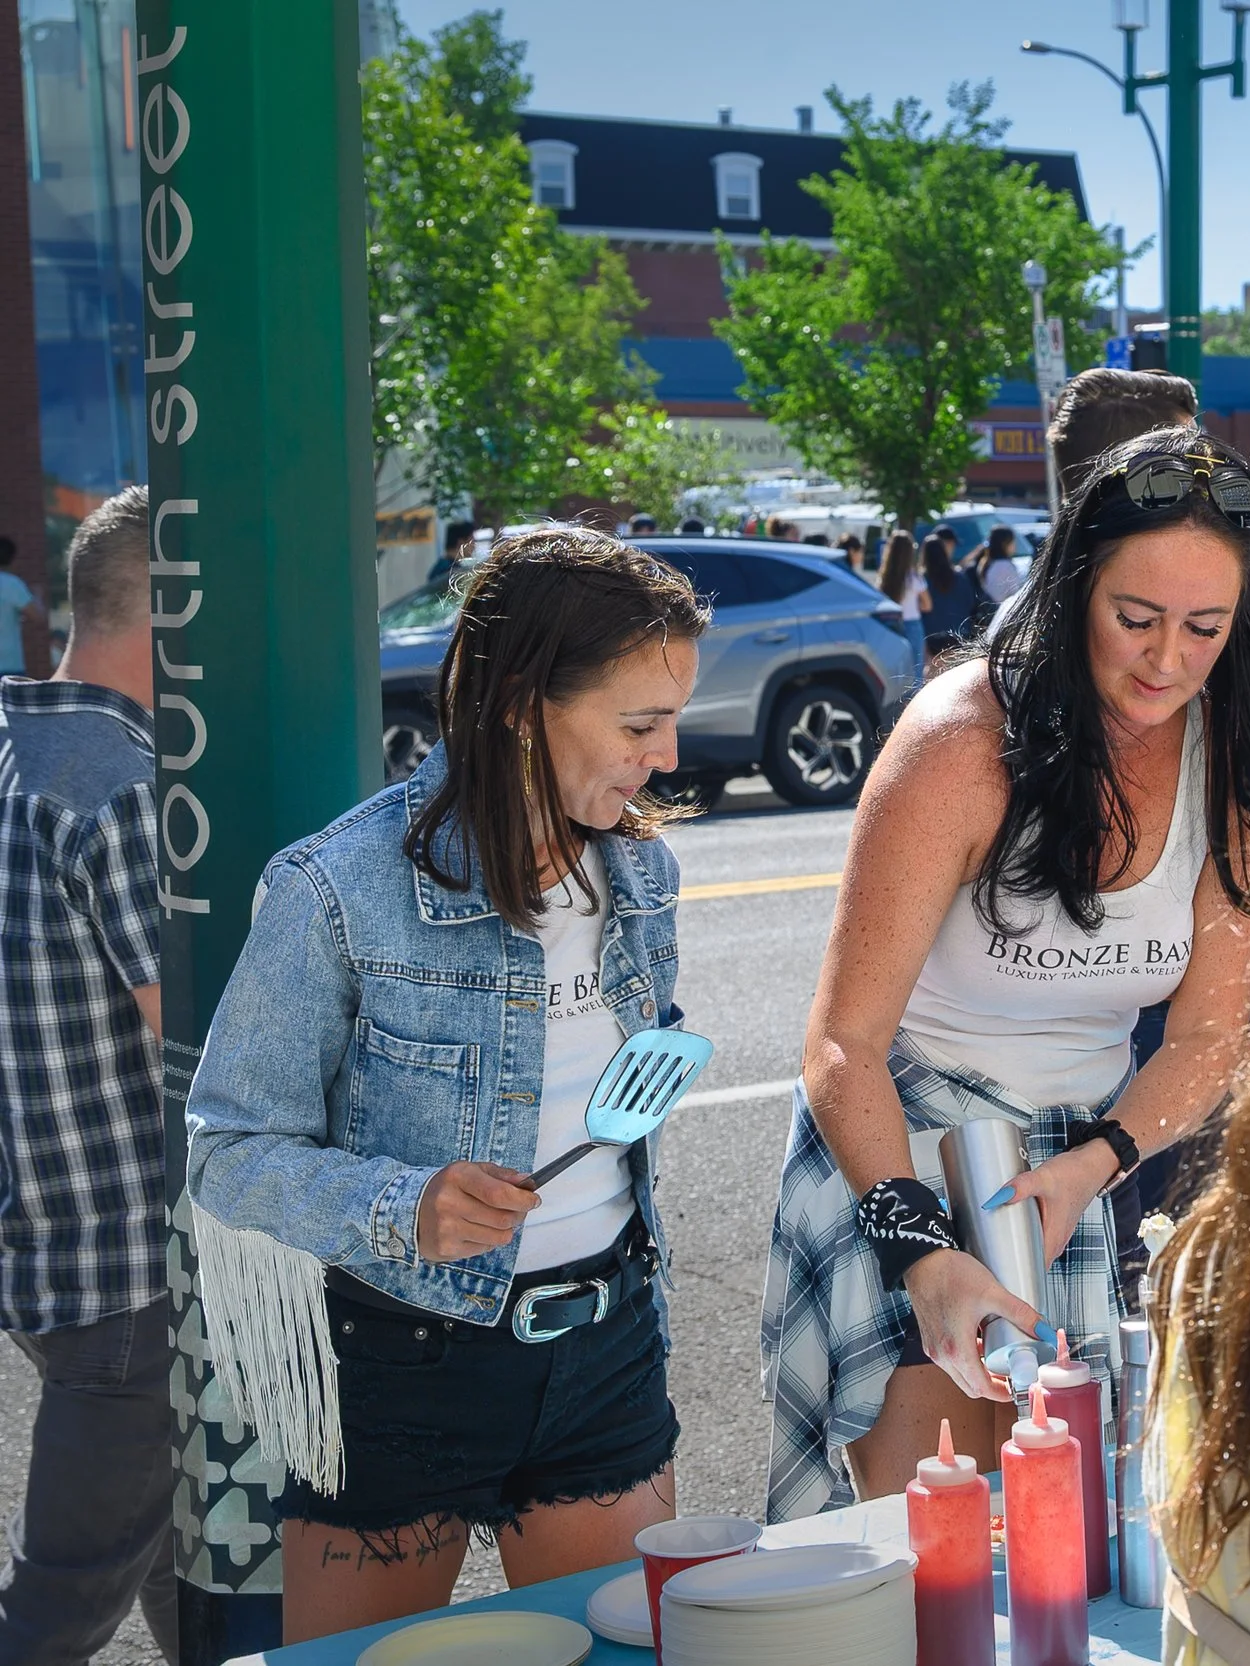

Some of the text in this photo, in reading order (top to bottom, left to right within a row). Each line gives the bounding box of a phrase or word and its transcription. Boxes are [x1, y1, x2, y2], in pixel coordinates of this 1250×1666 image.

[137, 26, 211, 920] fourth street
[984, 932, 1131, 969] BRONZE
[996, 964, 1057, 982] LUXURY
[1061, 966, 1127, 980] TANNING
[1130, 966, 1140, 974] &
[566, 1008, 576, 1017] &
